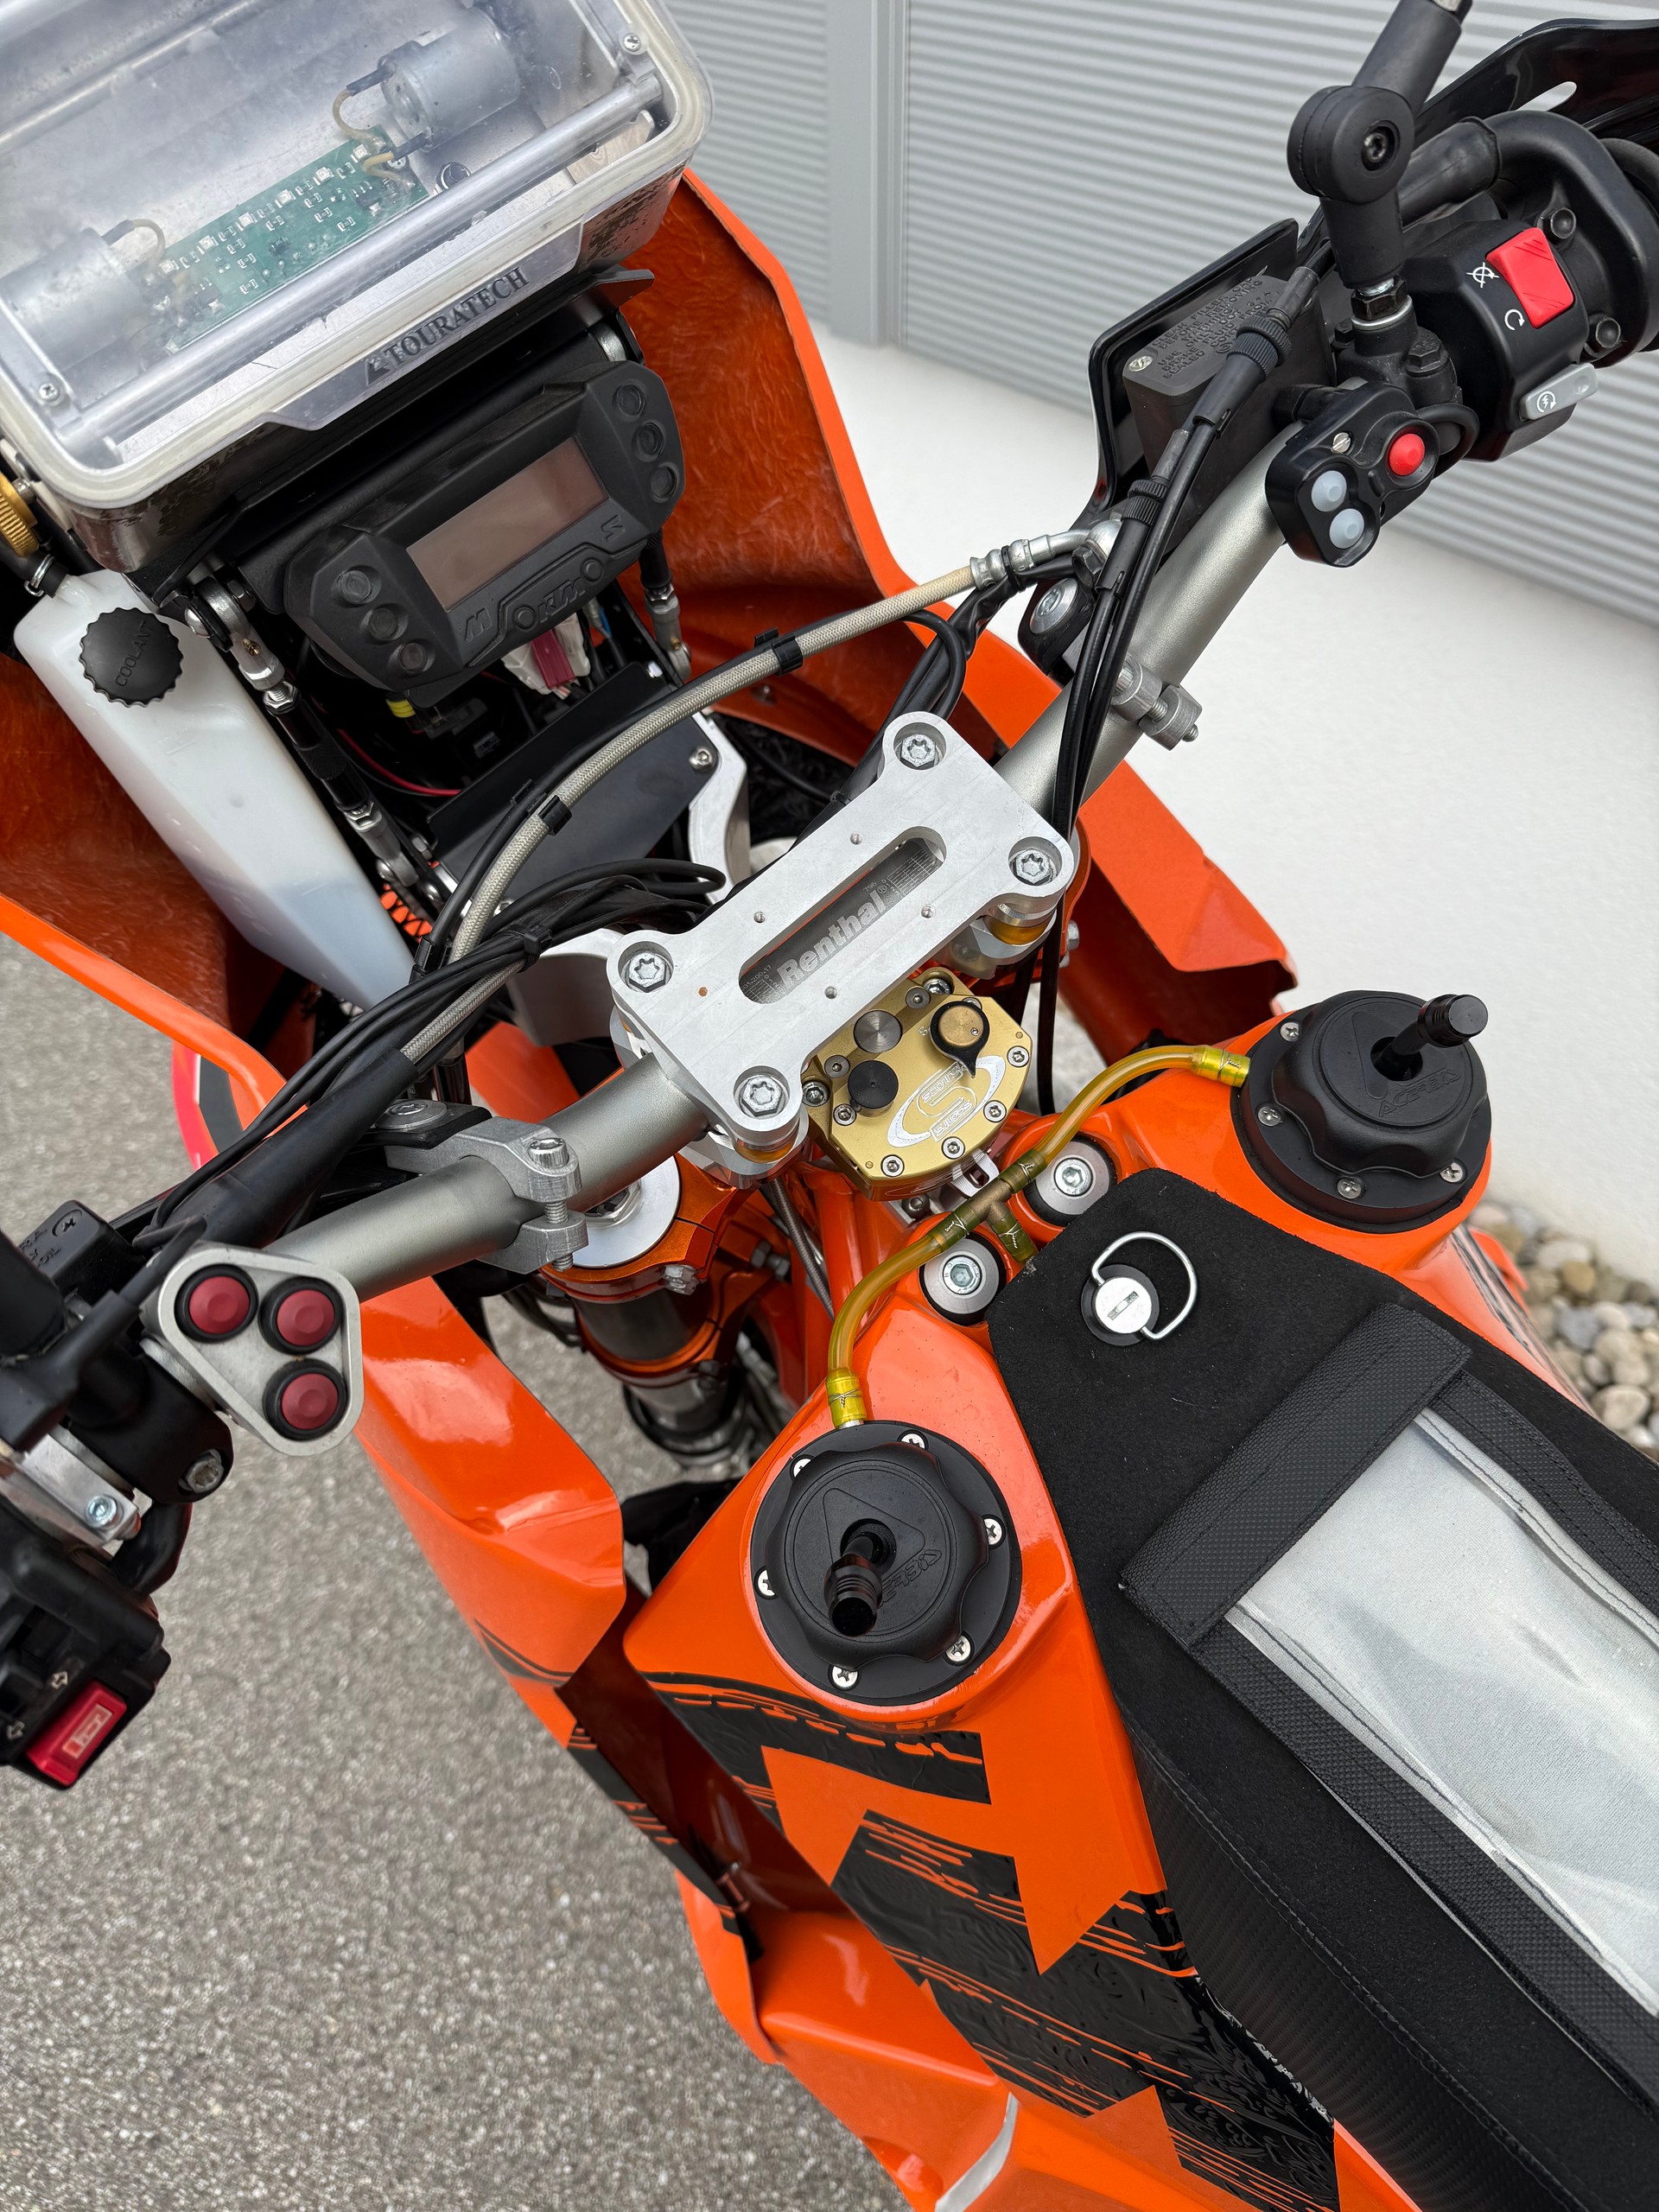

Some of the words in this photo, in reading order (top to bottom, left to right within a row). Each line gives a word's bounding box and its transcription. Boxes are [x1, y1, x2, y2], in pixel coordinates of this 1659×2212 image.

[384, 266, 530, 366] TOURATECH
[1191, 296, 1229, 321] FILLER
[1159, 321, 1203, 349] BEFORE
[1162, 346, 1199, 372] BRAKE
[1202, 323, 1235, 345] FLUID
[537, 576, 586, 624] KTM
[115, 620, 154, 687] COOLANT
[778, 890, 887, 988] Renthal
